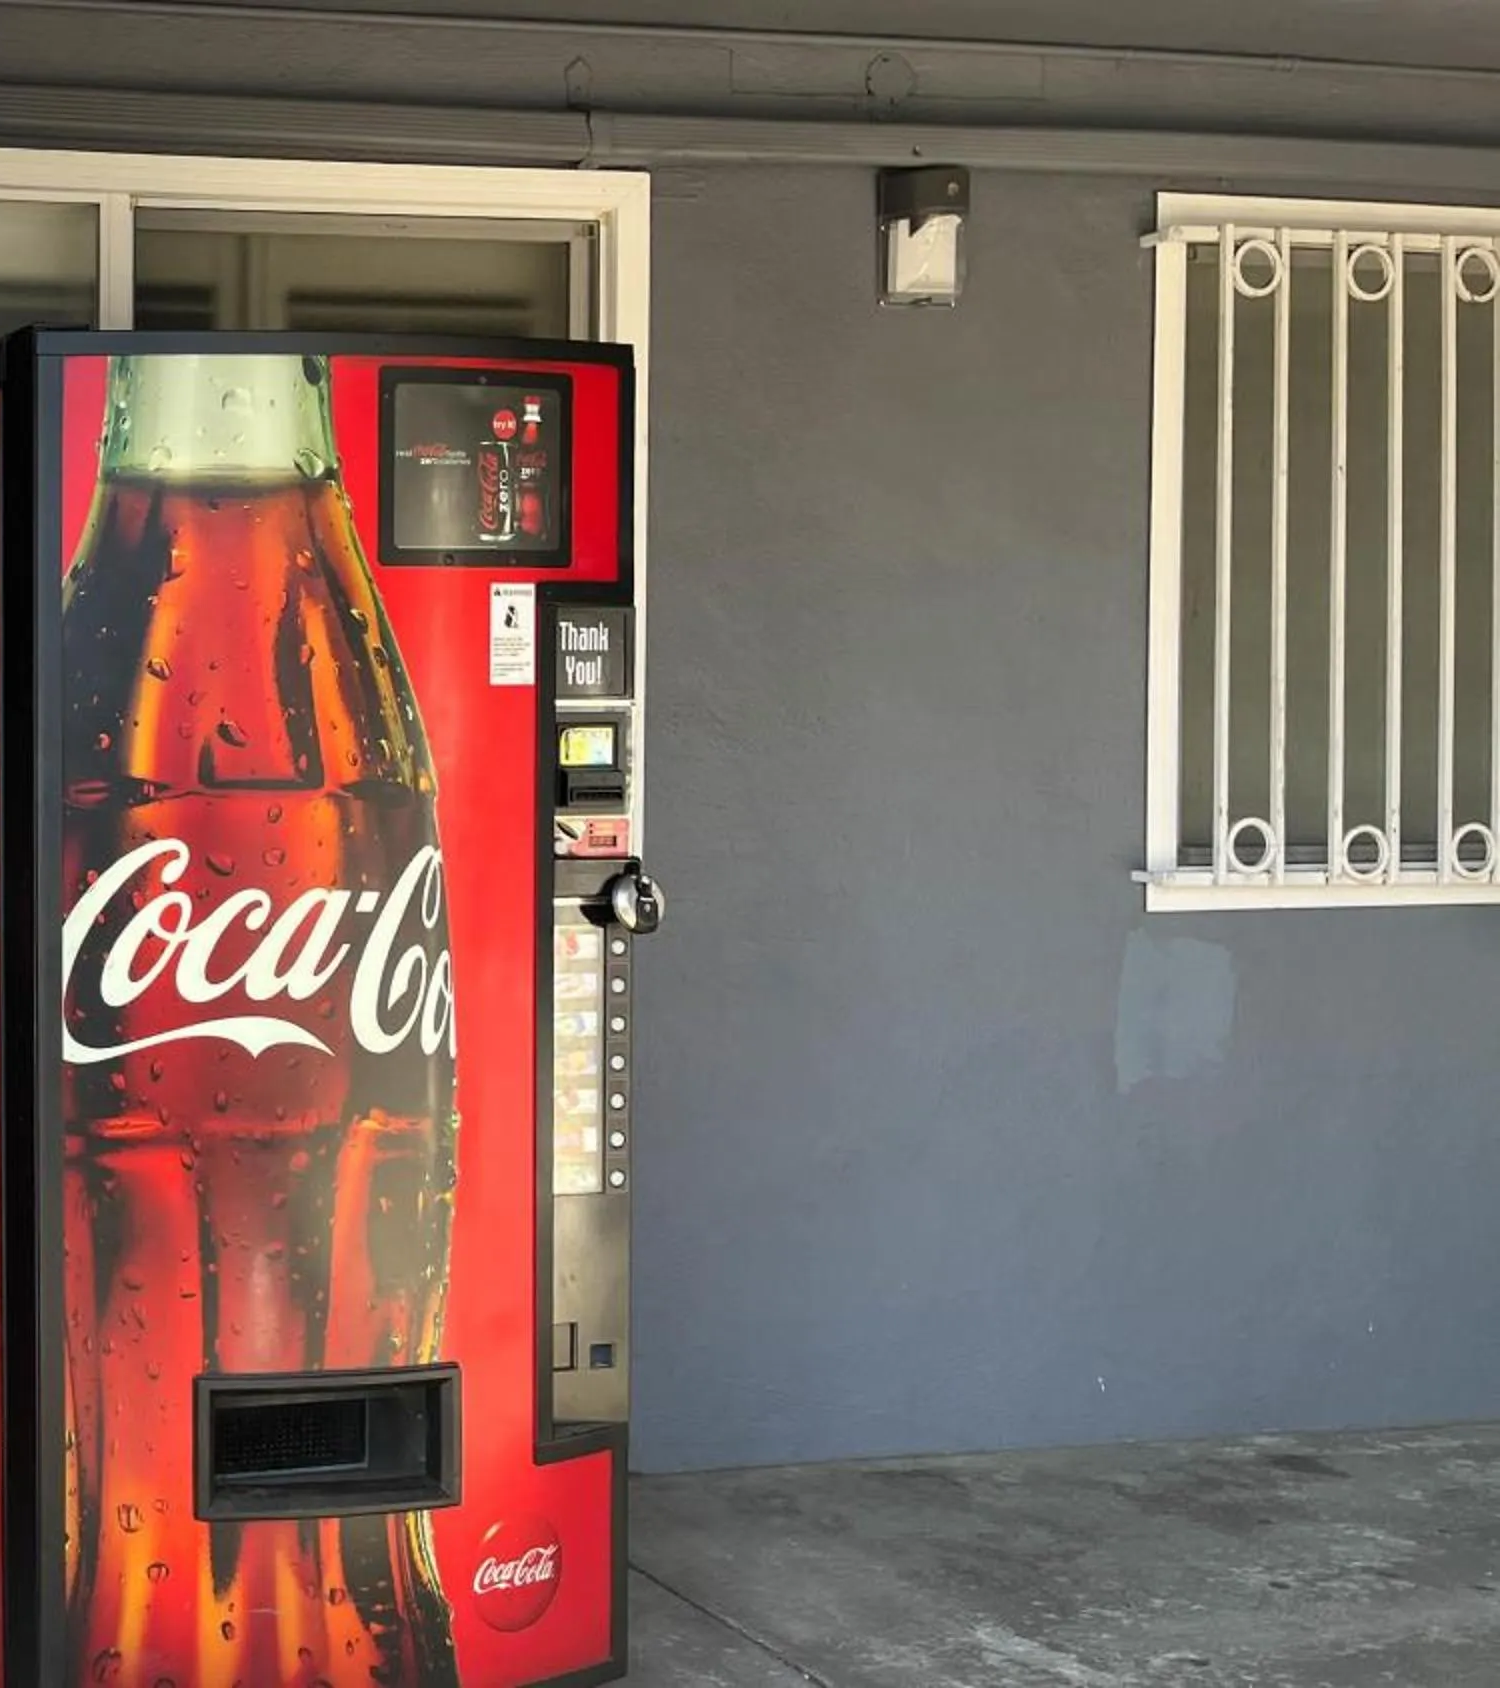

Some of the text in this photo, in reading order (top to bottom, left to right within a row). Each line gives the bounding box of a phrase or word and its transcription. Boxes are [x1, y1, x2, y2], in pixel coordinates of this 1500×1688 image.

[499, 469, 509, 513] zero
[559, 621, 609, 651] Thank
[565, 655, 602, 685] You!
[62, 838, 457, 1065] Coca-Co
[473, 1544, 558, 1594] Coca-Cola
